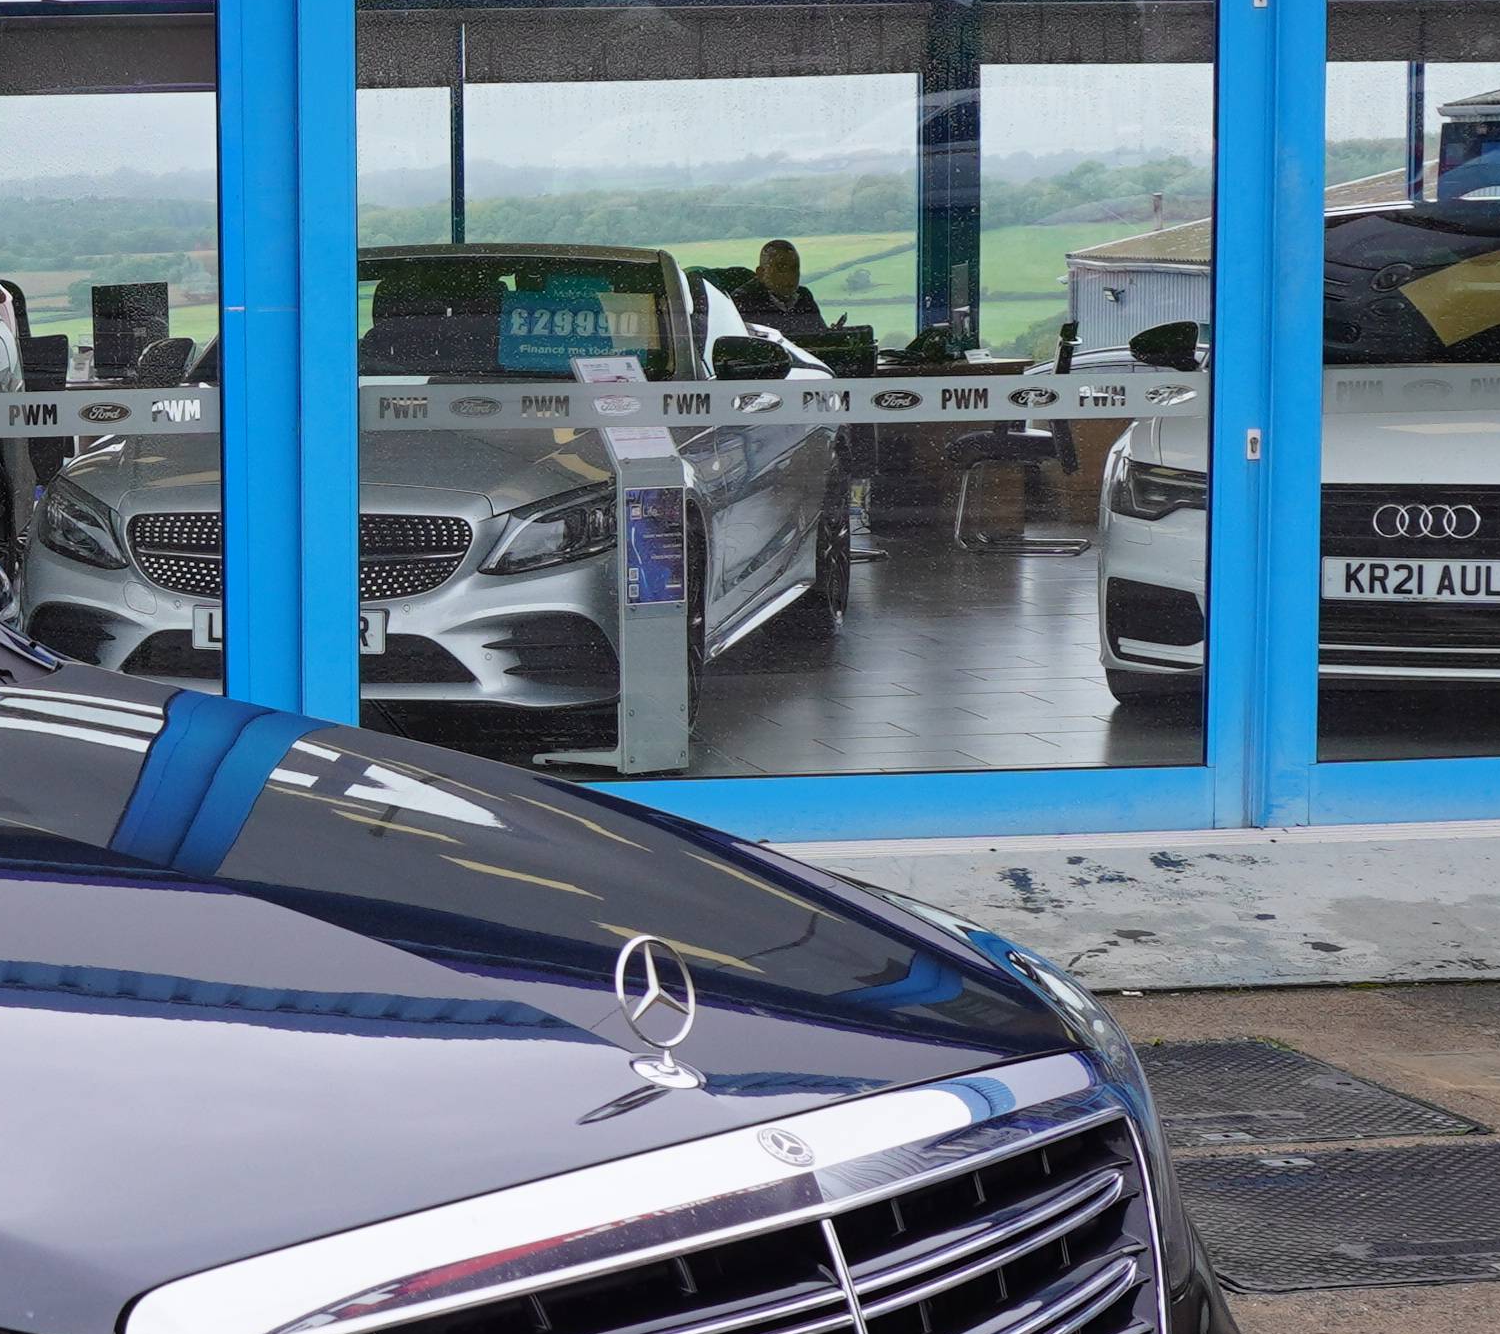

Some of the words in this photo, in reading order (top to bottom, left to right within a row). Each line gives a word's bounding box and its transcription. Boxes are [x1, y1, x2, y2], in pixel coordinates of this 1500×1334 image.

[510, 307, 640, 338] £29990
[518, 343, 566, 355] Finance
[567, 346, 587, 356] me
[8, 403, 58, 427] PWM
[151, 398, 201, 423] PWM
[379, 396, 428, 419] PWM
[521, 395, 571, 418] PWM
[941, 387, 989, 410] PWM
[1078, 384, 1127, 407] PWM
[1345, 561, 1425, 596] KR21
